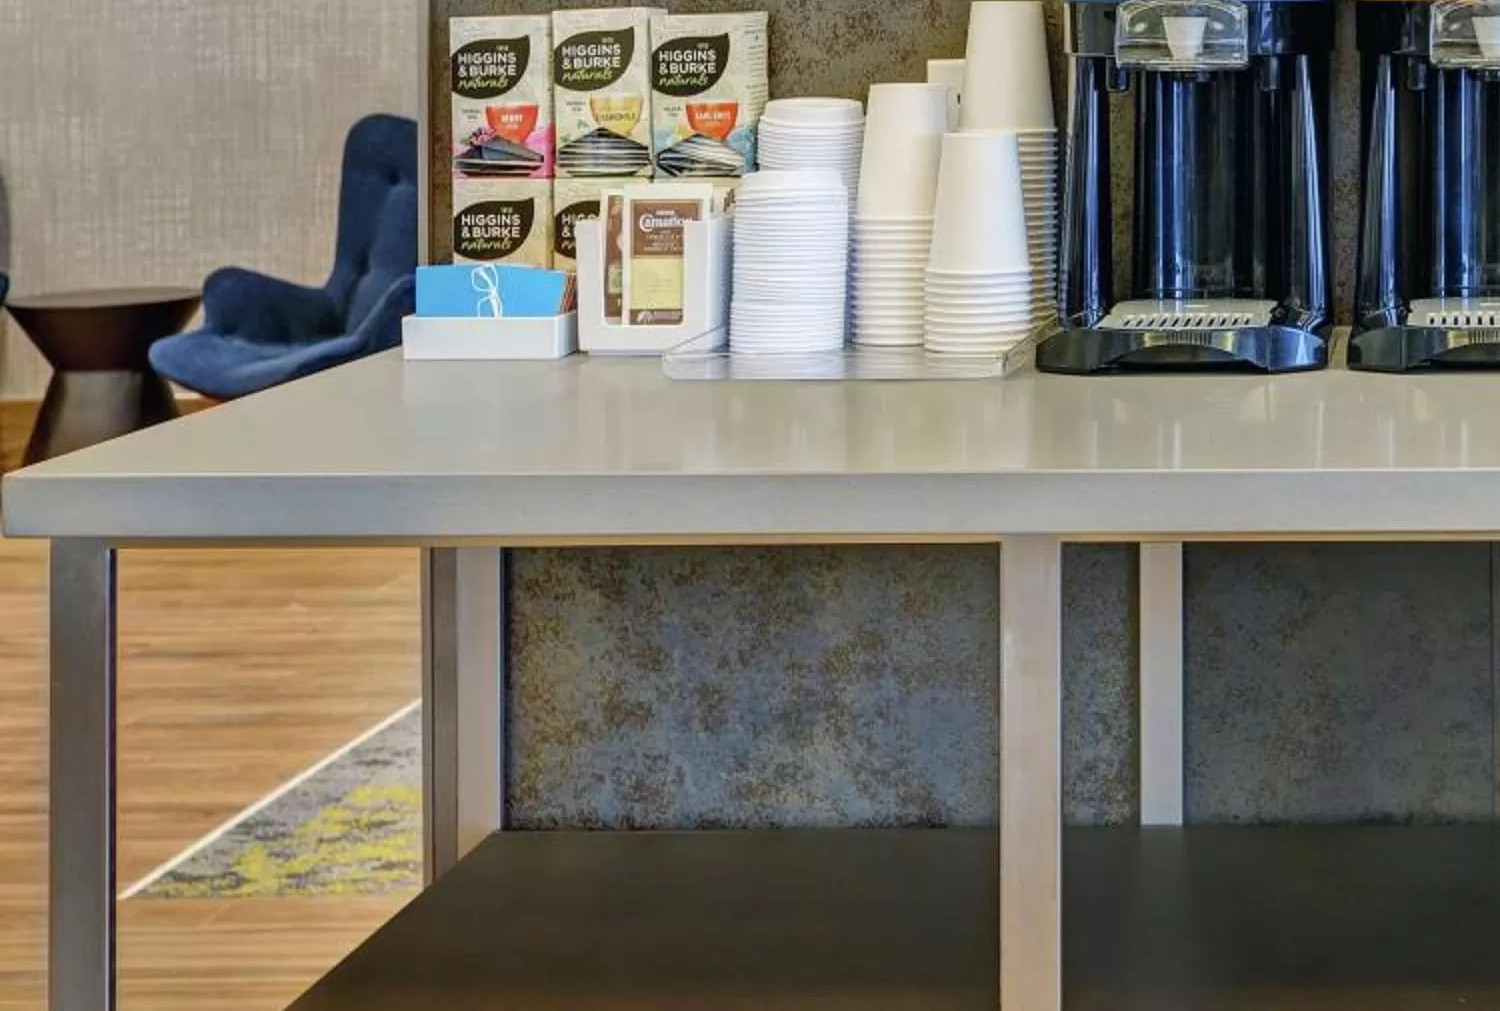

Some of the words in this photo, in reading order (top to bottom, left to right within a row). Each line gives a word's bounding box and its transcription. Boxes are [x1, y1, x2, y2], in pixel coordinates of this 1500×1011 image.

[562, 44, 621, 57] HIGGINS
[658, 50, 717, 62] HIGGINS
[457, 52, 517, 65] HIGGINS
[573, 56, 621, 69] BURKE
[469, 64, 517, 77] BURKE
[669, 62, 717, 75] BURKE
[461, 214, 521, 226] HIGGINS
[472, 226, 521, 238] BURKE
